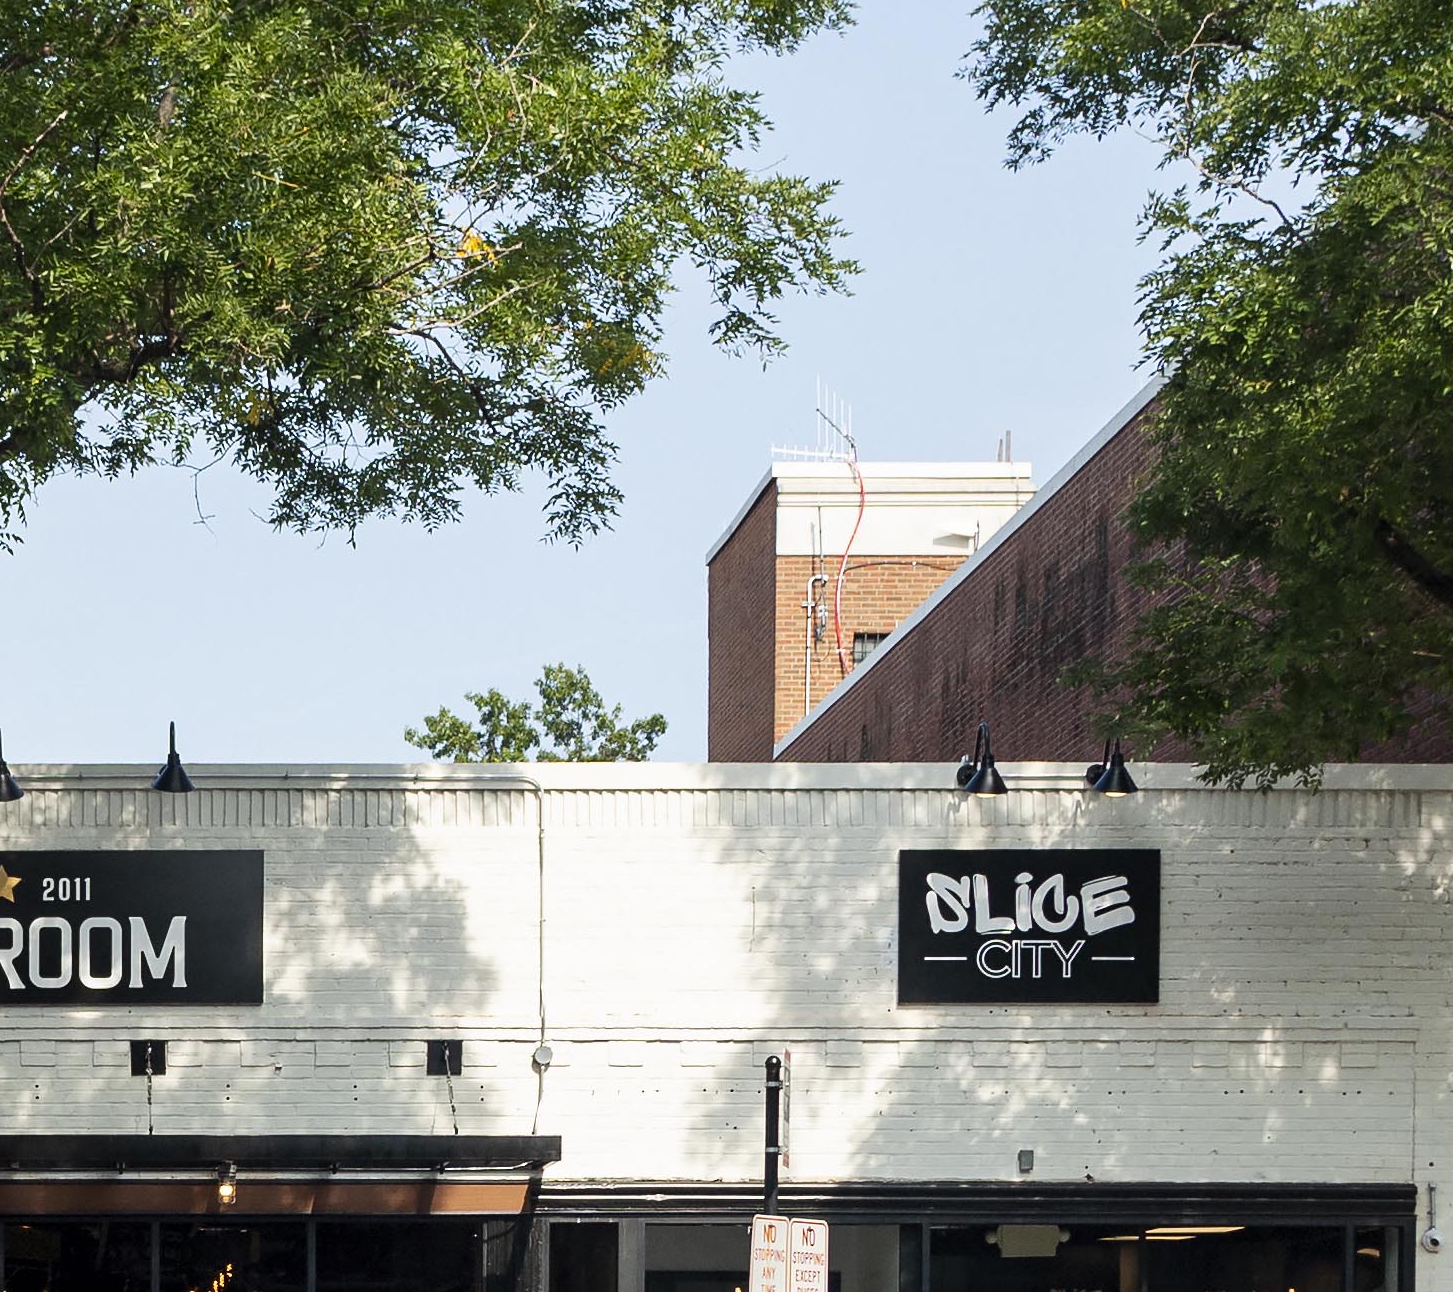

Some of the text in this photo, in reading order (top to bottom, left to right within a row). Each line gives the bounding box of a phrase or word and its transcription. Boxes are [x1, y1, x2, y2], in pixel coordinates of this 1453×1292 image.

[42, 877, 91, 902] 2011
[976, 939, 1086, 979] CITY
[763, 1224, 777, 1244] NO
[802, 1227, 816, 1247] NO
[754, 1248, 785, 1263] STOPPING
[793, 1252, 824, 1266] STOPPING
[762, 1268, 775, 1280] ANY
[795, 1270, 821, 1283] EXCEPT
